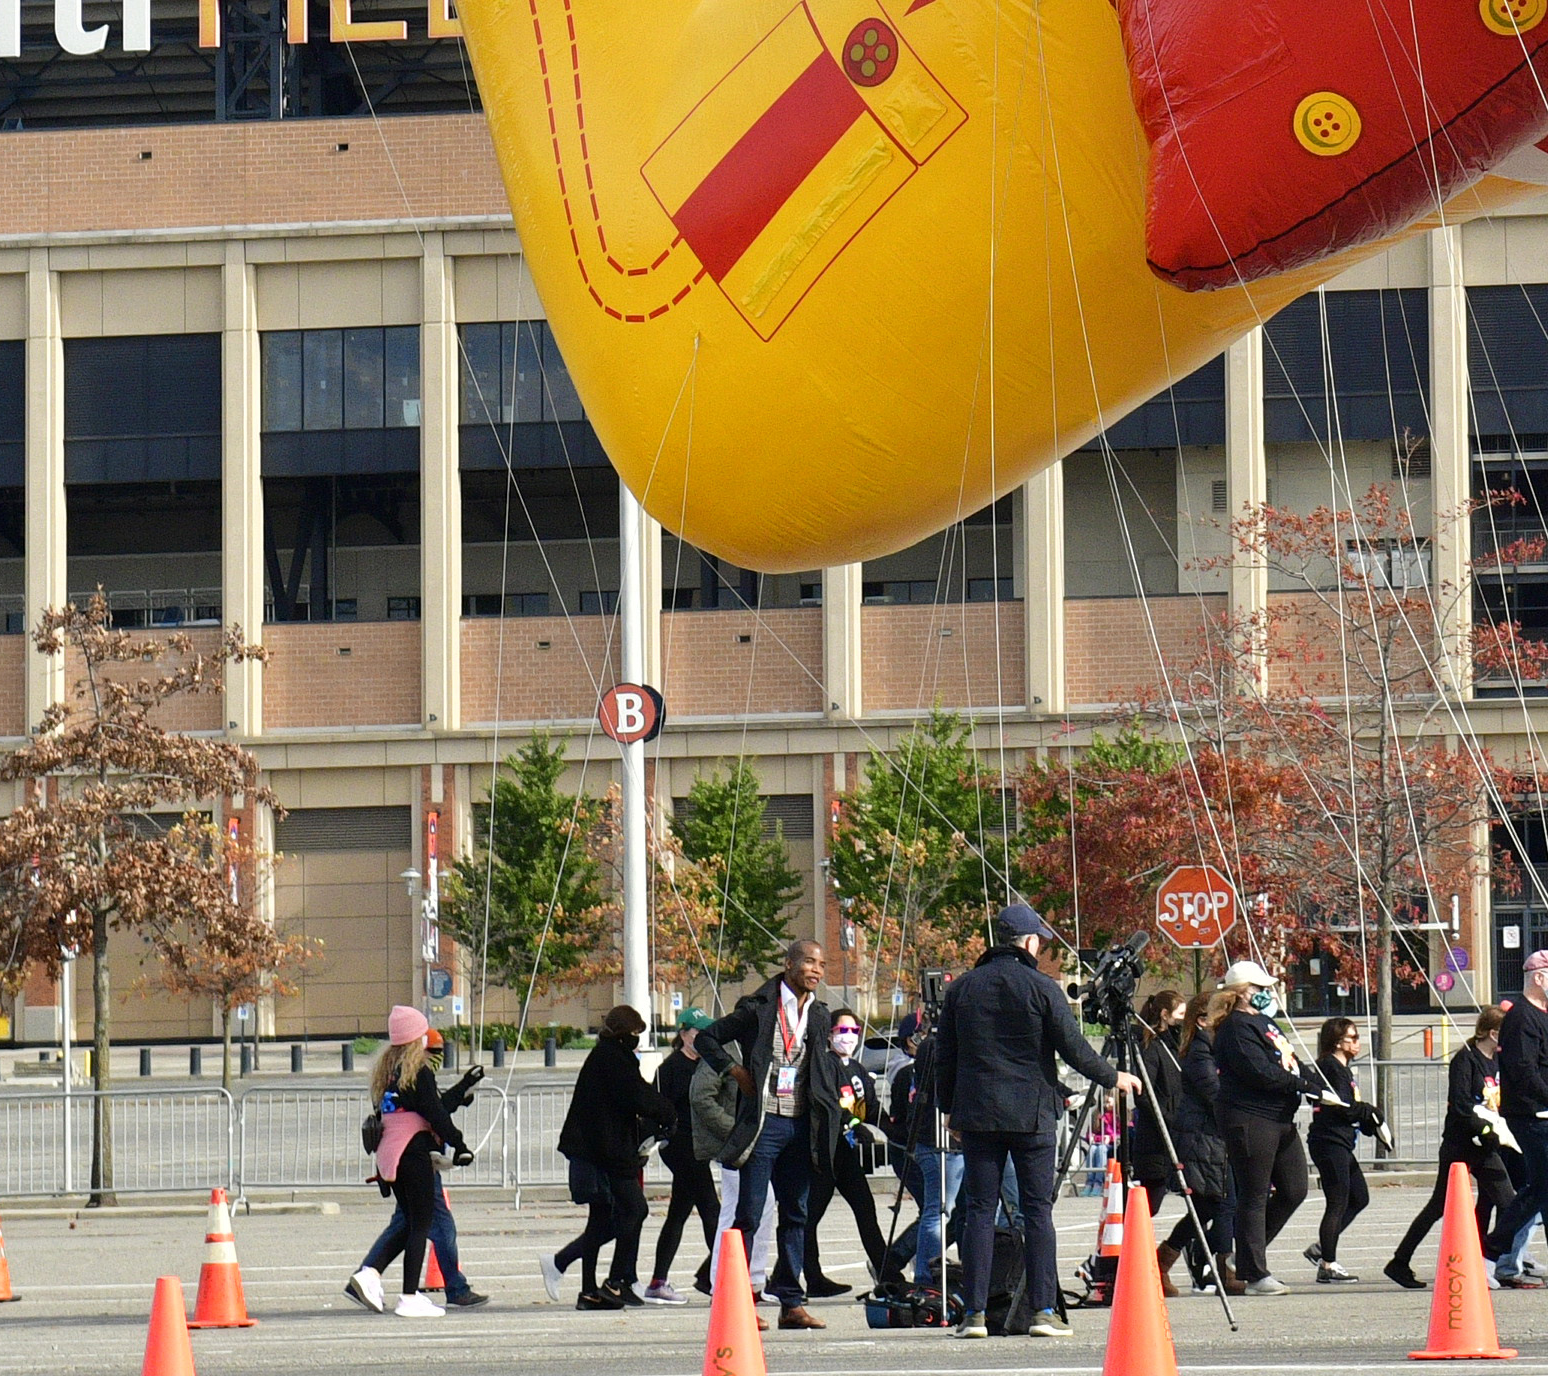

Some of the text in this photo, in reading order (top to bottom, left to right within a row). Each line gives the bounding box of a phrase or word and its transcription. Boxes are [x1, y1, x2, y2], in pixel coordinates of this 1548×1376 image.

[616, 692, 645, 734] B
[1163, 891, 1229, 923] STOP
[1446, 1253, 1466, 1330] macy's
